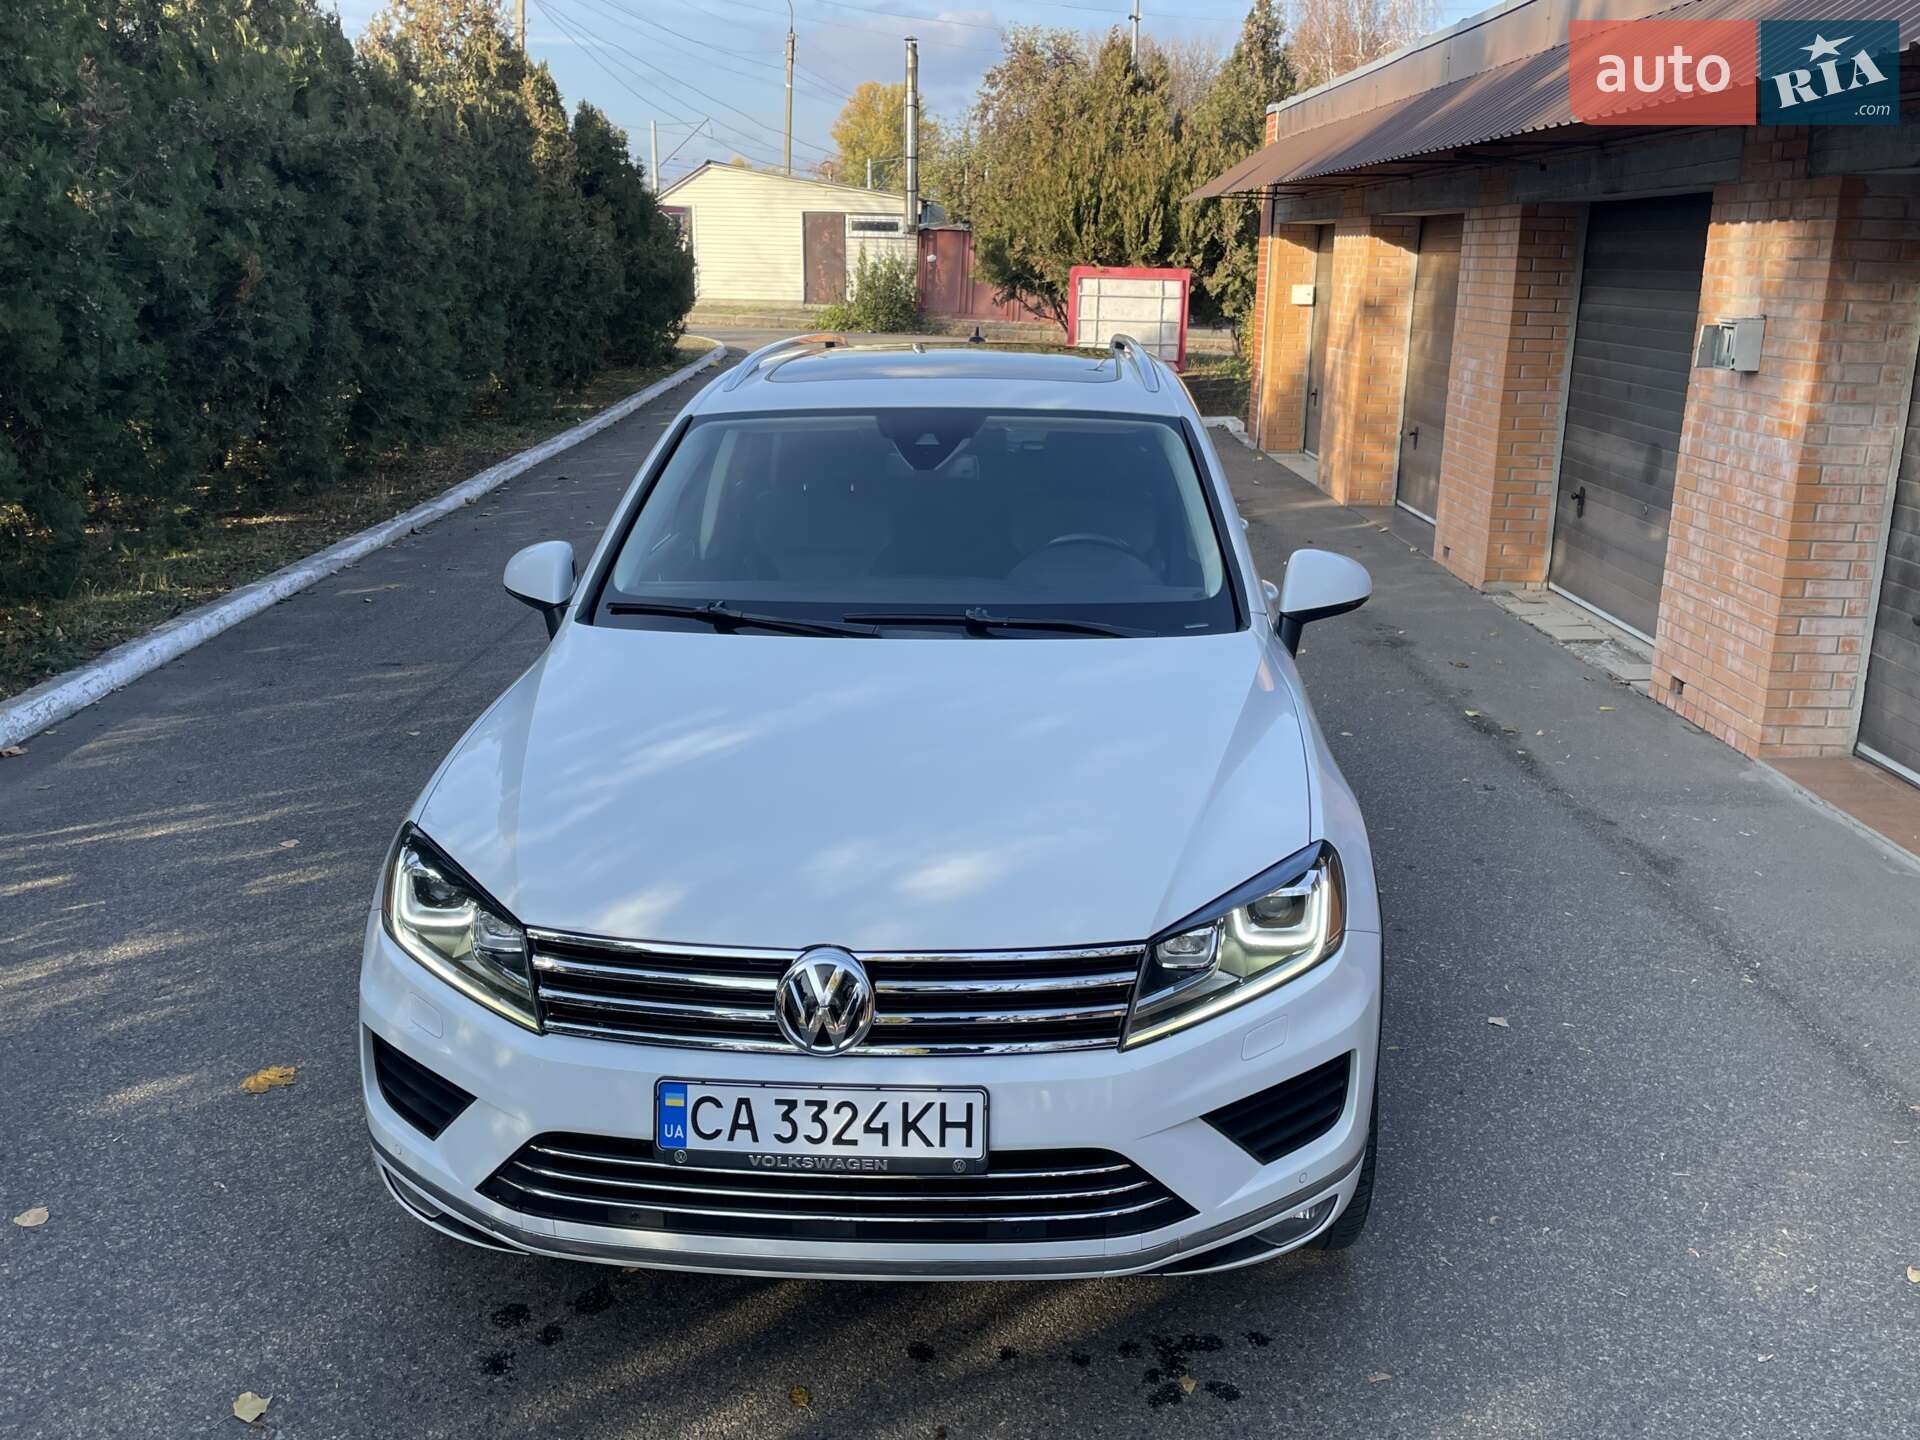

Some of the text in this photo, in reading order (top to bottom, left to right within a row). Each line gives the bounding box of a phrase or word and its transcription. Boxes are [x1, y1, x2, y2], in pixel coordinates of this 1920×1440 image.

[691, 1095, 973, 1148] CA 3324 KH
[664, 1123, 684, 1139] UA
[748, 1154, 889, 1171] VOLKSWAGEN
